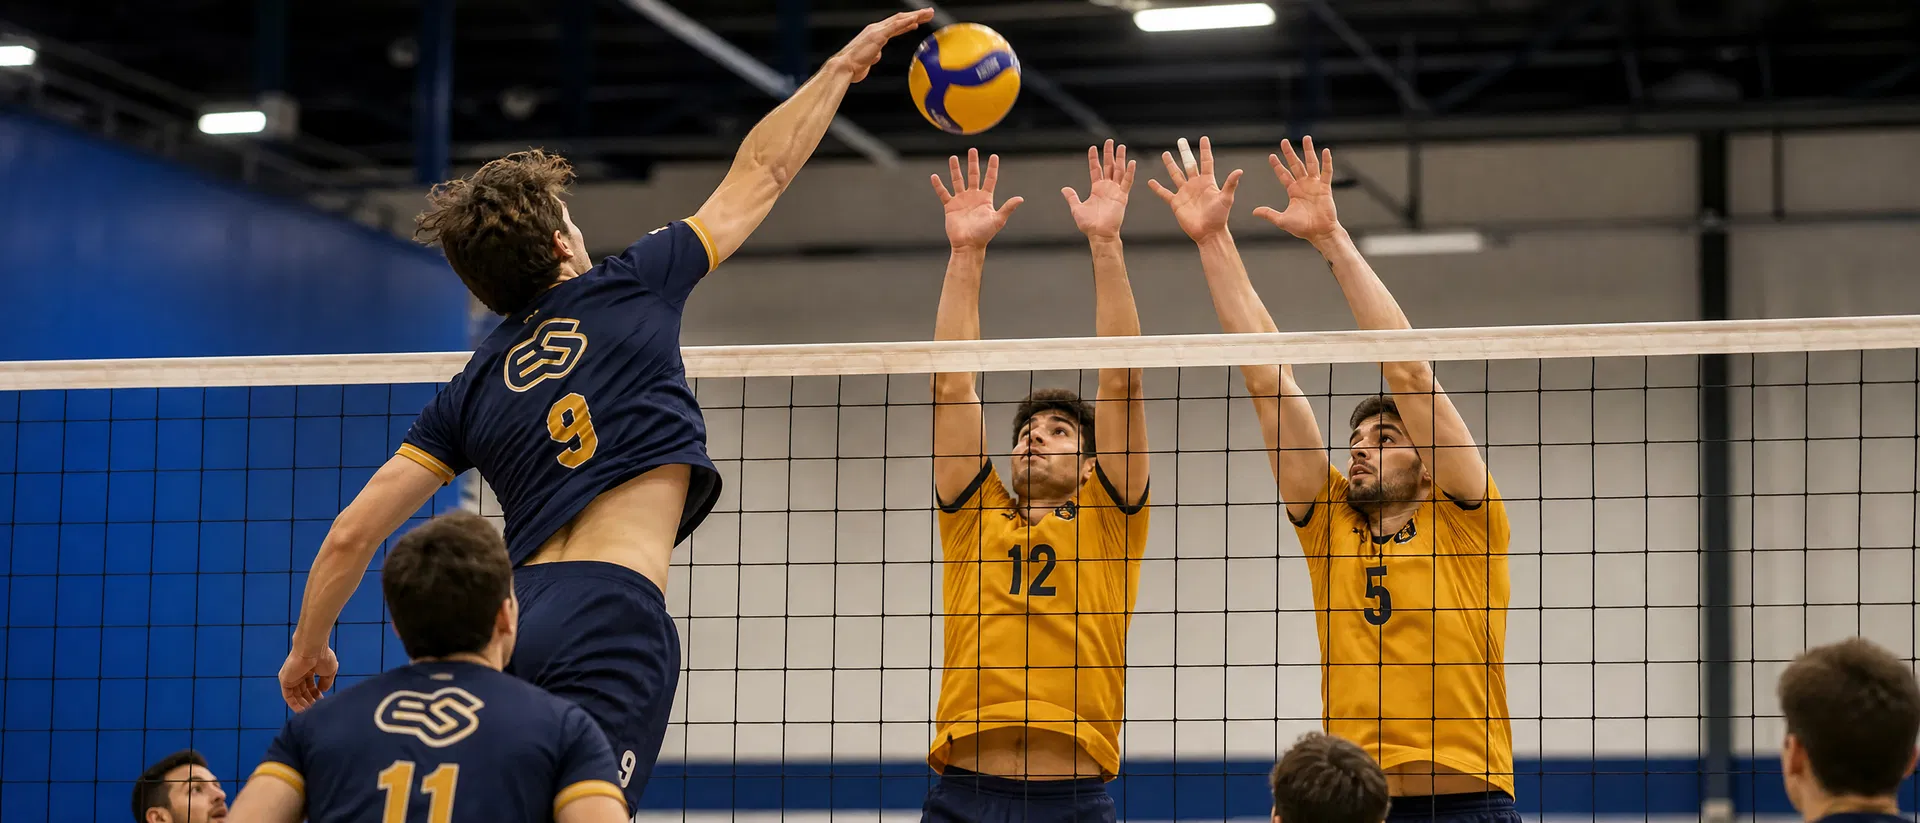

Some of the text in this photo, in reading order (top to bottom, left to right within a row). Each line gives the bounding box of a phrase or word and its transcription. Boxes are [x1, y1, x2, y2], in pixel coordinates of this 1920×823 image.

[546, 393, 599, 469] 9
[1008, 543, 1057, 597] 12
[1364, 565, 1392, 626] 5
[377, 759, 460, 823] 11
[617, 750, 637, 788] 9
